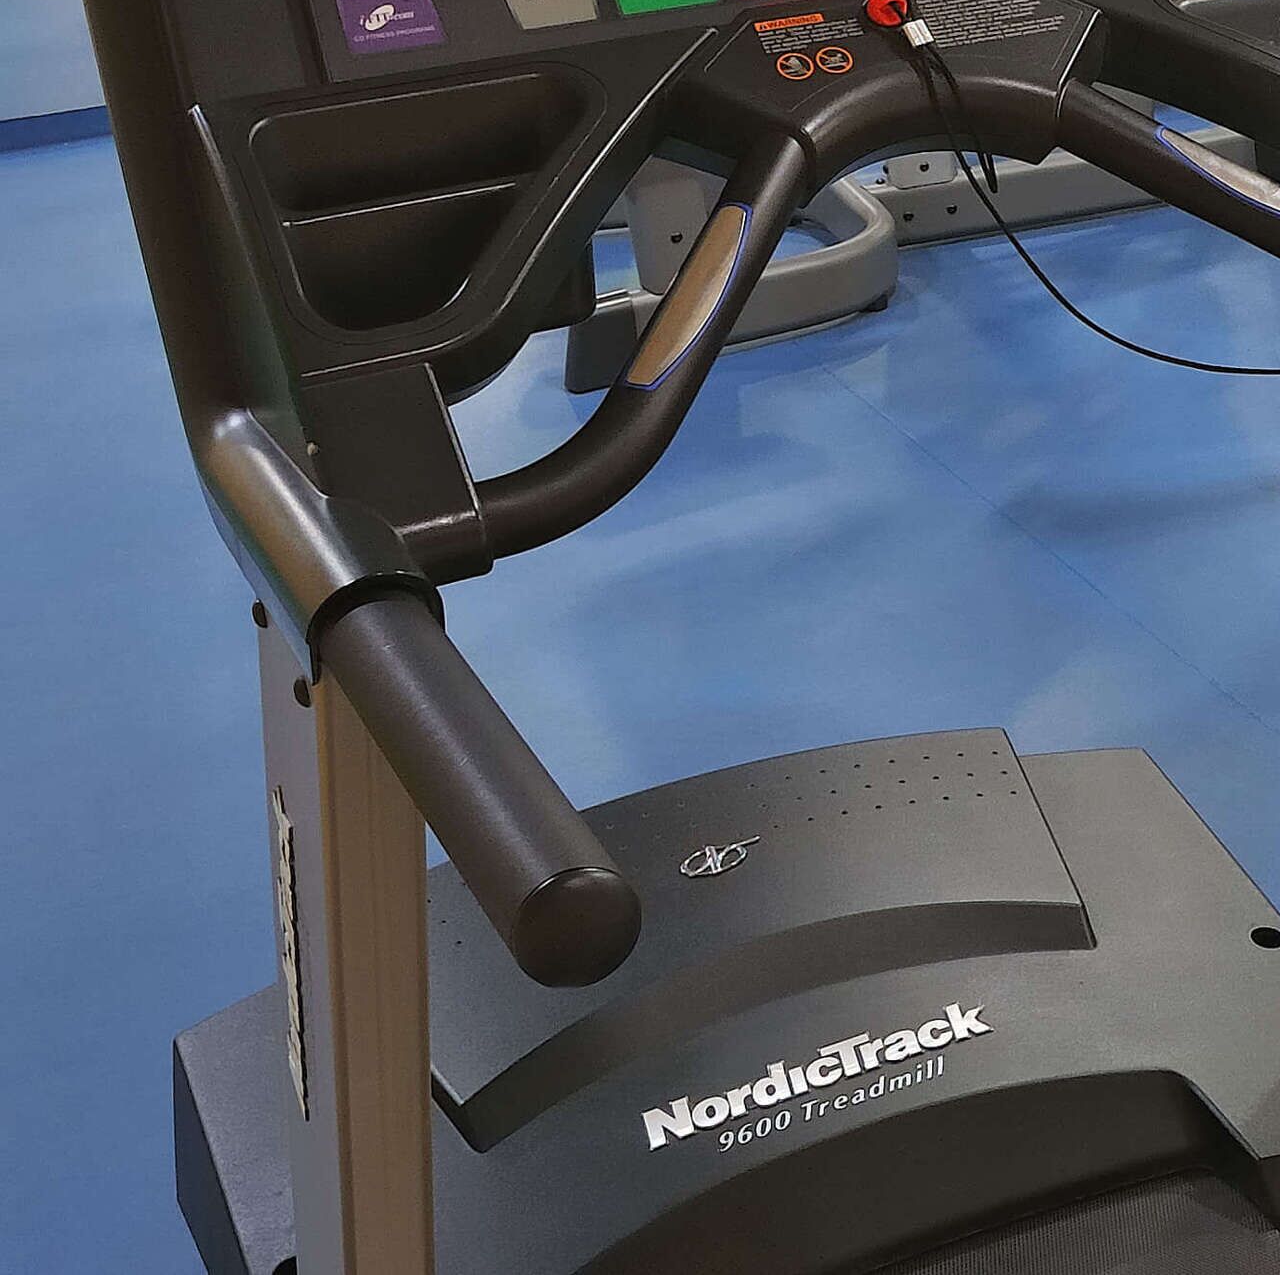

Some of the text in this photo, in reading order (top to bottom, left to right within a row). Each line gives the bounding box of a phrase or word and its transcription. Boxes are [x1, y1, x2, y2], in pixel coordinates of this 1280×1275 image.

[641, 1002, 994, 1152] NordicTrack
[718, 1056, 945, 1153] 9600 Treadmill
